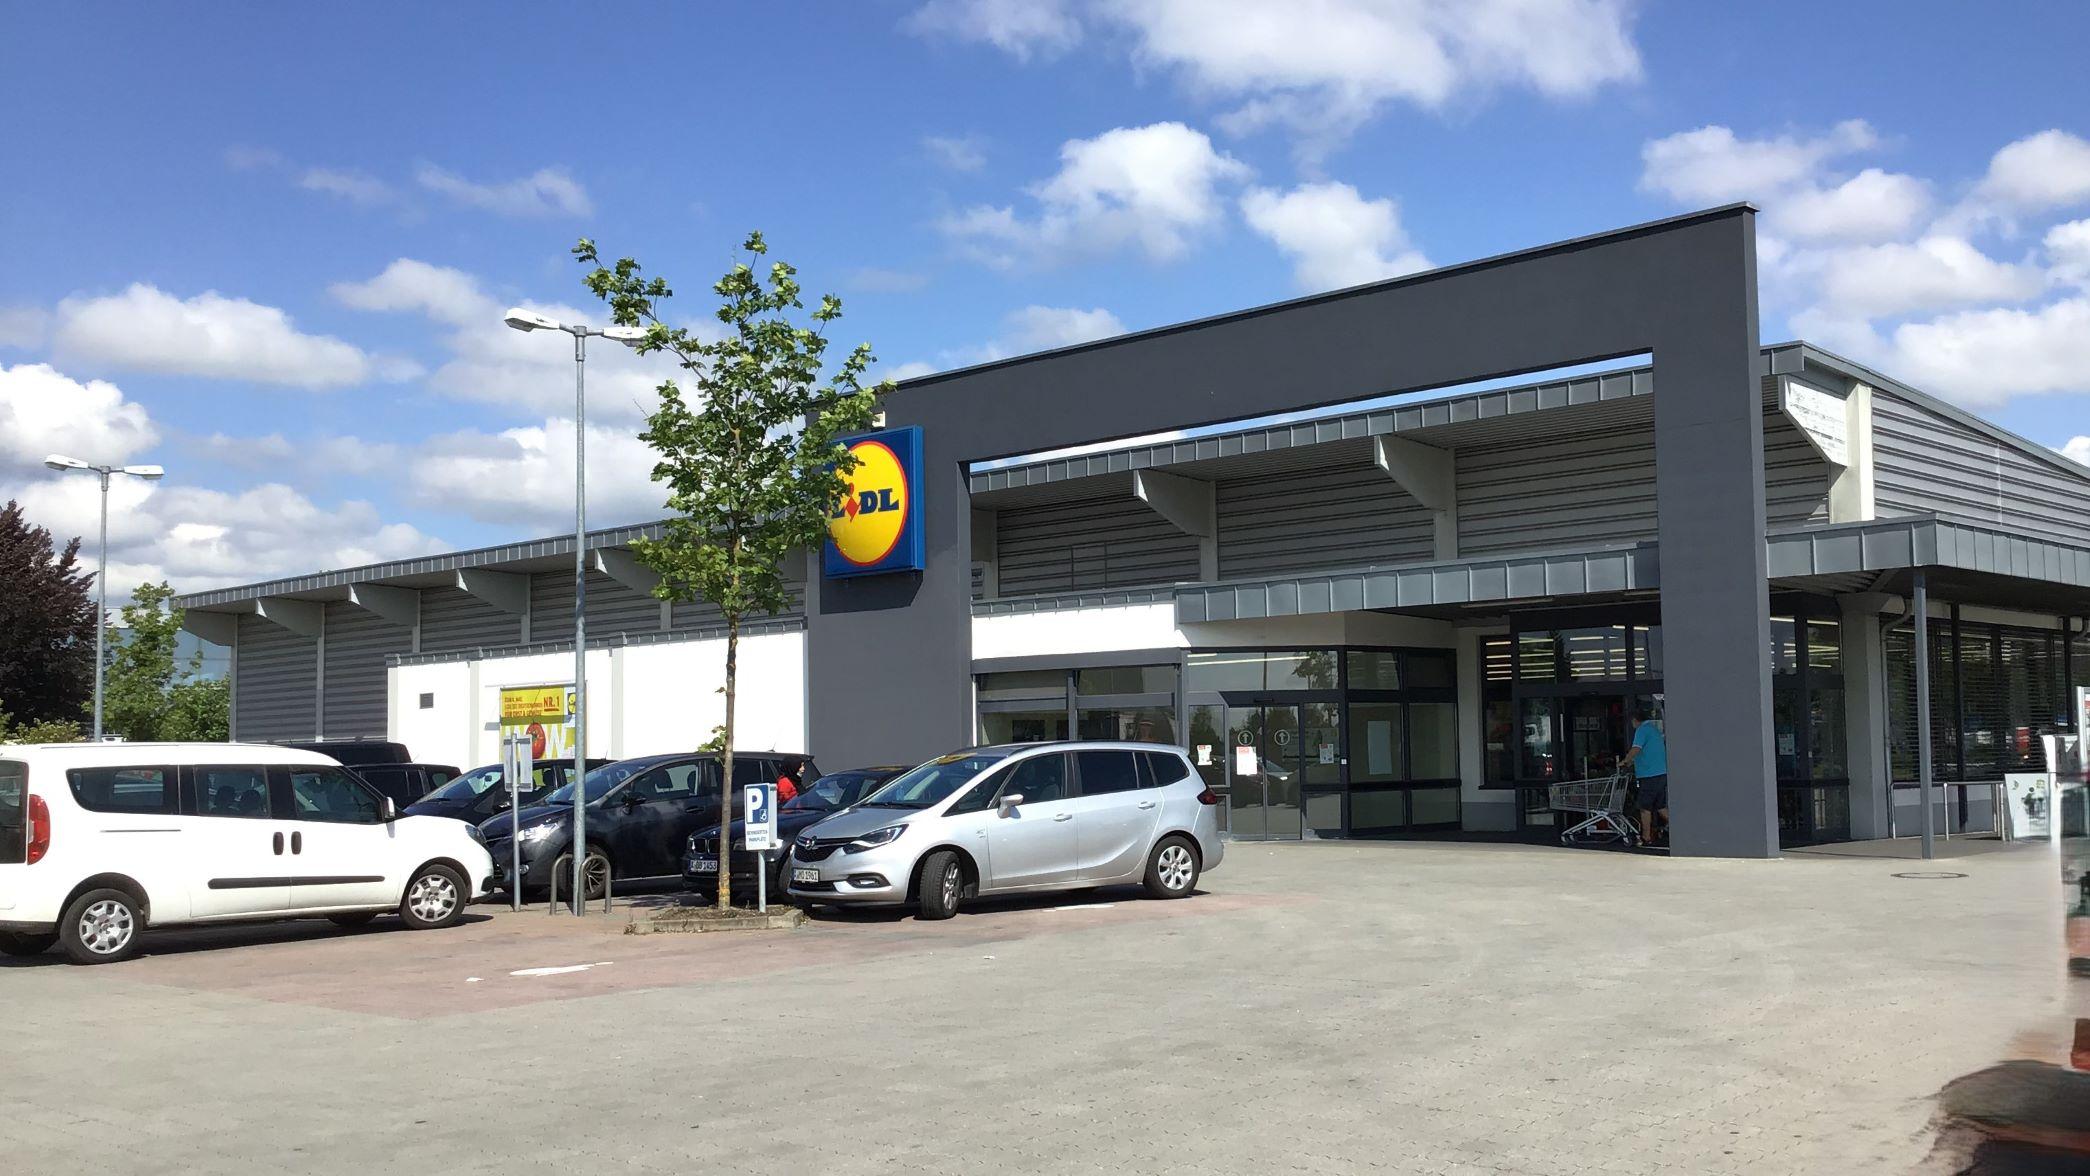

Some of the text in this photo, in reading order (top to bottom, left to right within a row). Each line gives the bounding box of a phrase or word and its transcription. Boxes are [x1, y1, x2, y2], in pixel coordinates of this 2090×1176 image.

[543, 696, 556, 708] NR.
[556, 696, 560, 707] 1
[746, 787, 763, 823] P
